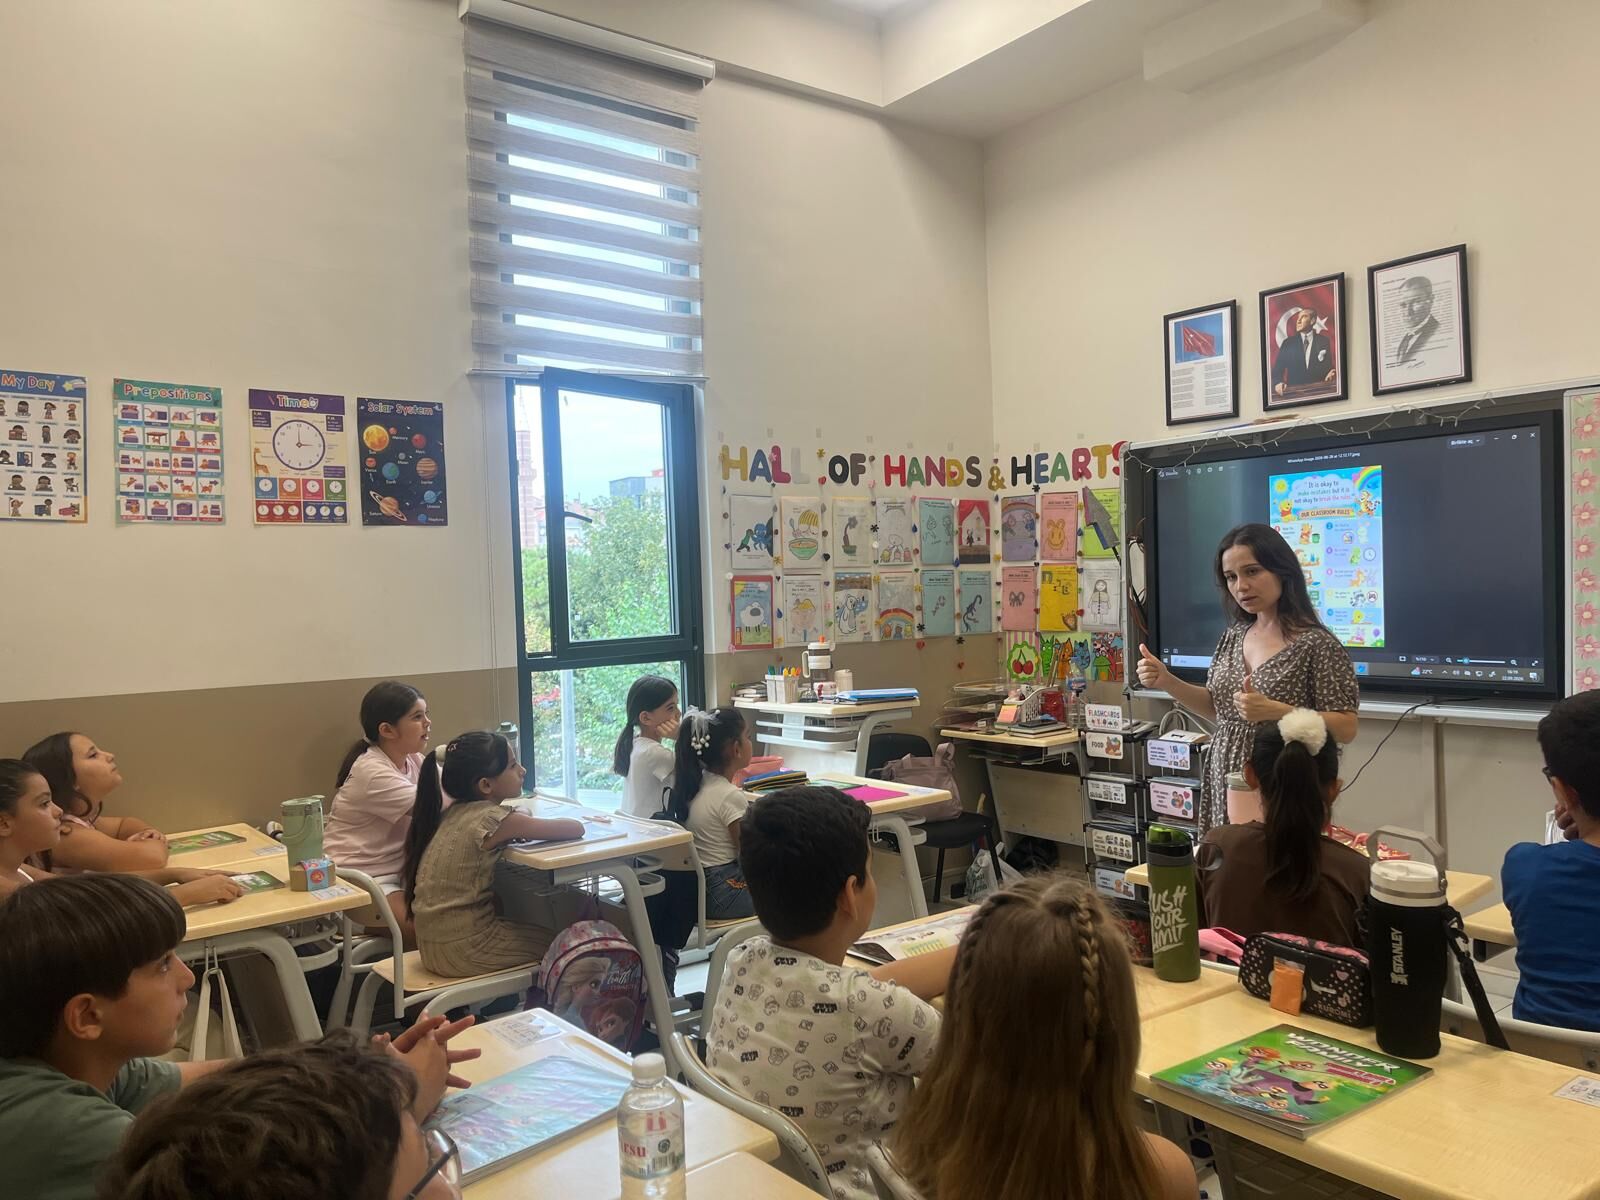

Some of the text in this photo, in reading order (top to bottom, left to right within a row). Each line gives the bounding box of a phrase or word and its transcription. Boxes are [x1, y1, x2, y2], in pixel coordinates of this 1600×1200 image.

[1, 373, 55, 392] My Day
[123, 383, 212, 401] Prepositions
[276, 394, 309, 408] Time
[367, 402, 434, 416] Solar System
[721, 445, 810, 484] HALL
[828, 453, 867, 487] OF
[883, 454, 982, 487] HANDS
[987, 465, 1007, 492] &
[1320, 480, 1332, 489] okay
[1302, 497, 1313, 505] okay
[1310, 509, 1336, 517] CLASSROOM
[1088, 709, 1120, 719] FLASHCARDS
[1091, 741, 1104, 749] FOOD
[1152, 885, 1188, 913] USH
[1390, 926, 1405, 974] STANLEY
[1287, 1032, 1400, 1074] WONDER
